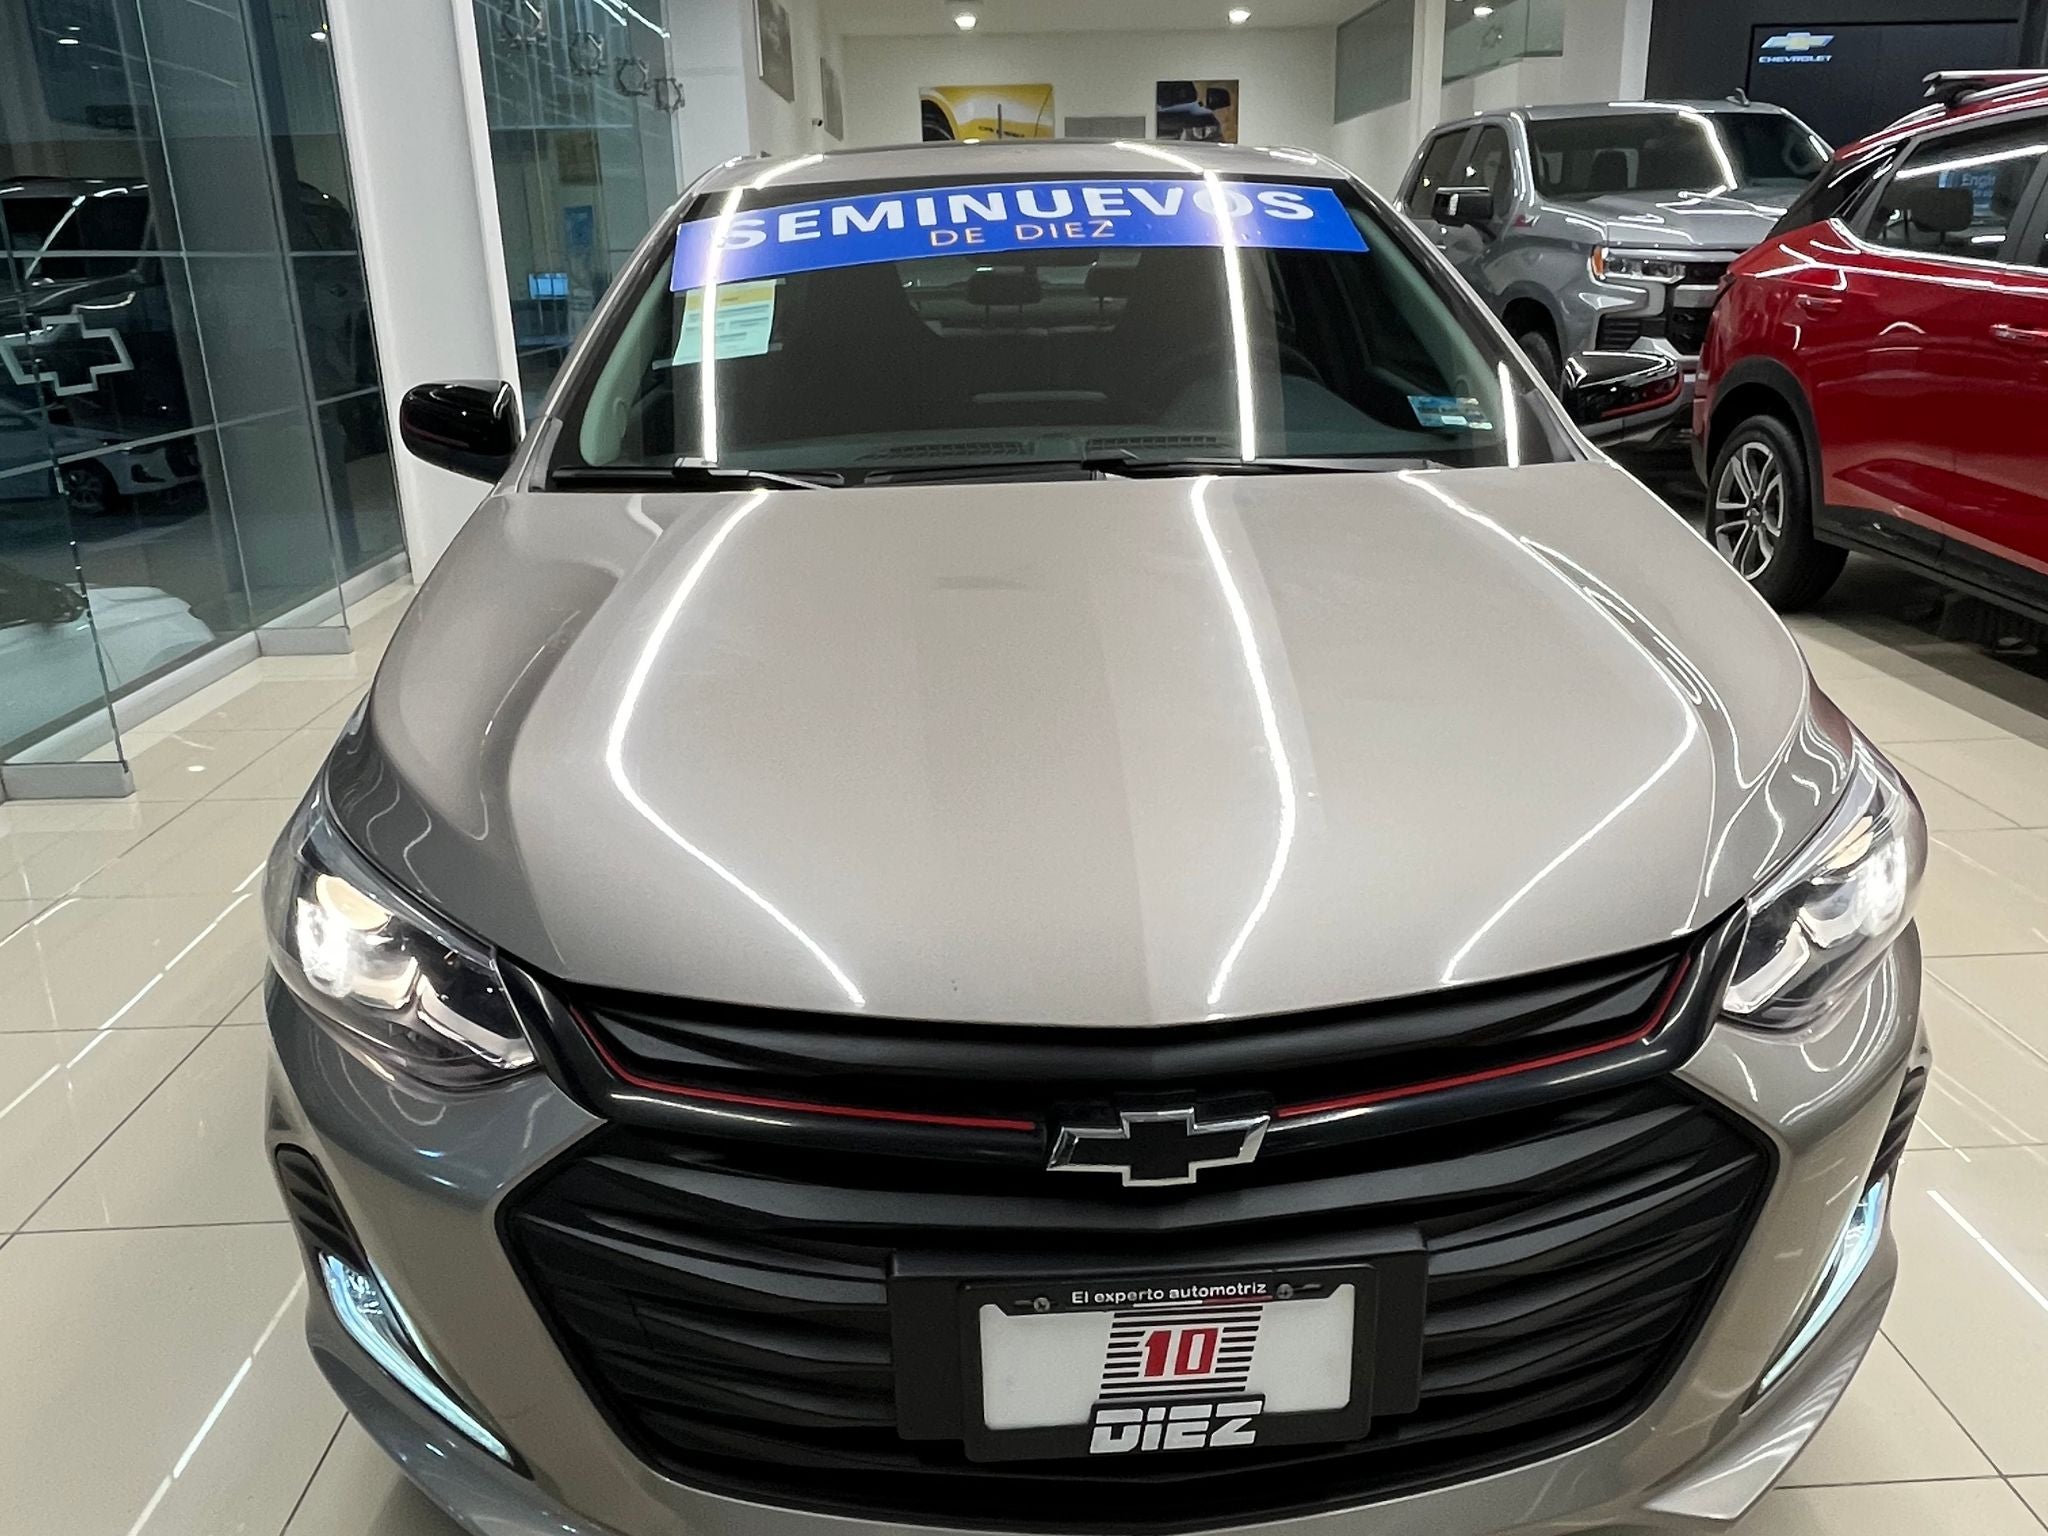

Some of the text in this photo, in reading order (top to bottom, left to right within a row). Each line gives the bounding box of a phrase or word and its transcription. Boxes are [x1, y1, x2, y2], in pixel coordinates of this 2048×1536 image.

[1758, 55, 1832, 63] CHEVROLET
[715, 187, 1314, 250] SEMINUEVOS
[931, 220, 1115, 247] DE DIEZ
[1072, 1282, 1267, 1305] El experto automotriz
[1144, 1329, 1219, 1377] 10
